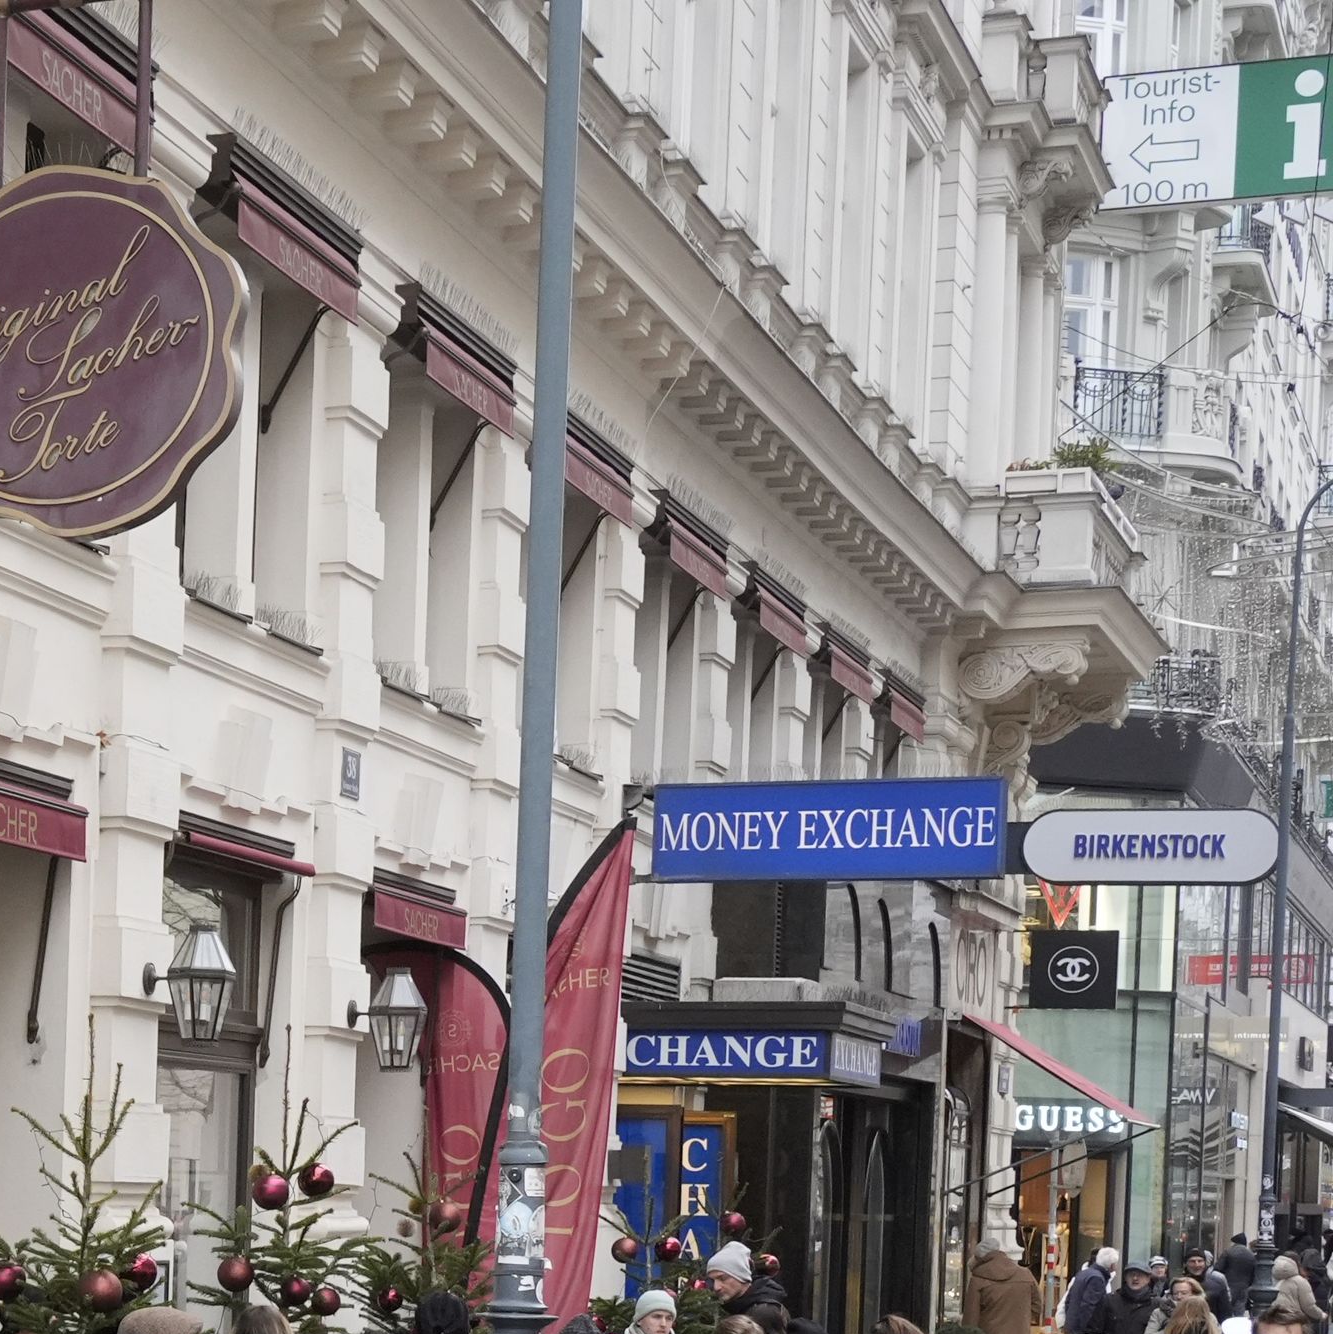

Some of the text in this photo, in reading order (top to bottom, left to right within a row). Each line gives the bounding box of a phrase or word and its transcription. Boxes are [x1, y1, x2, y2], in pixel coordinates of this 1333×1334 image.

[40, 48, 102, 128] SACHER
[1119, 71, 1221, 100] Tourist-
[1142, 98, 1196, 126] Info
[1120, 179, 1209, 206] 100 m
[278, 236, 324, 296] SACHER
[659, 806, 996, 852] MONEY EXCHANGE
[1072, 833, 1226, 861] BIRKENSTOCK
[404, 907, 439, 940] SACHER
[956, 927, 987, 1008] CIRO
[626, 1034, 819, 1069] CHANGE
[834, 1038, 878, 1077] EXCHANGE
[540, 1047, 590, 1142] GO
[1015, 1104, 1125, 1134] GUESS
